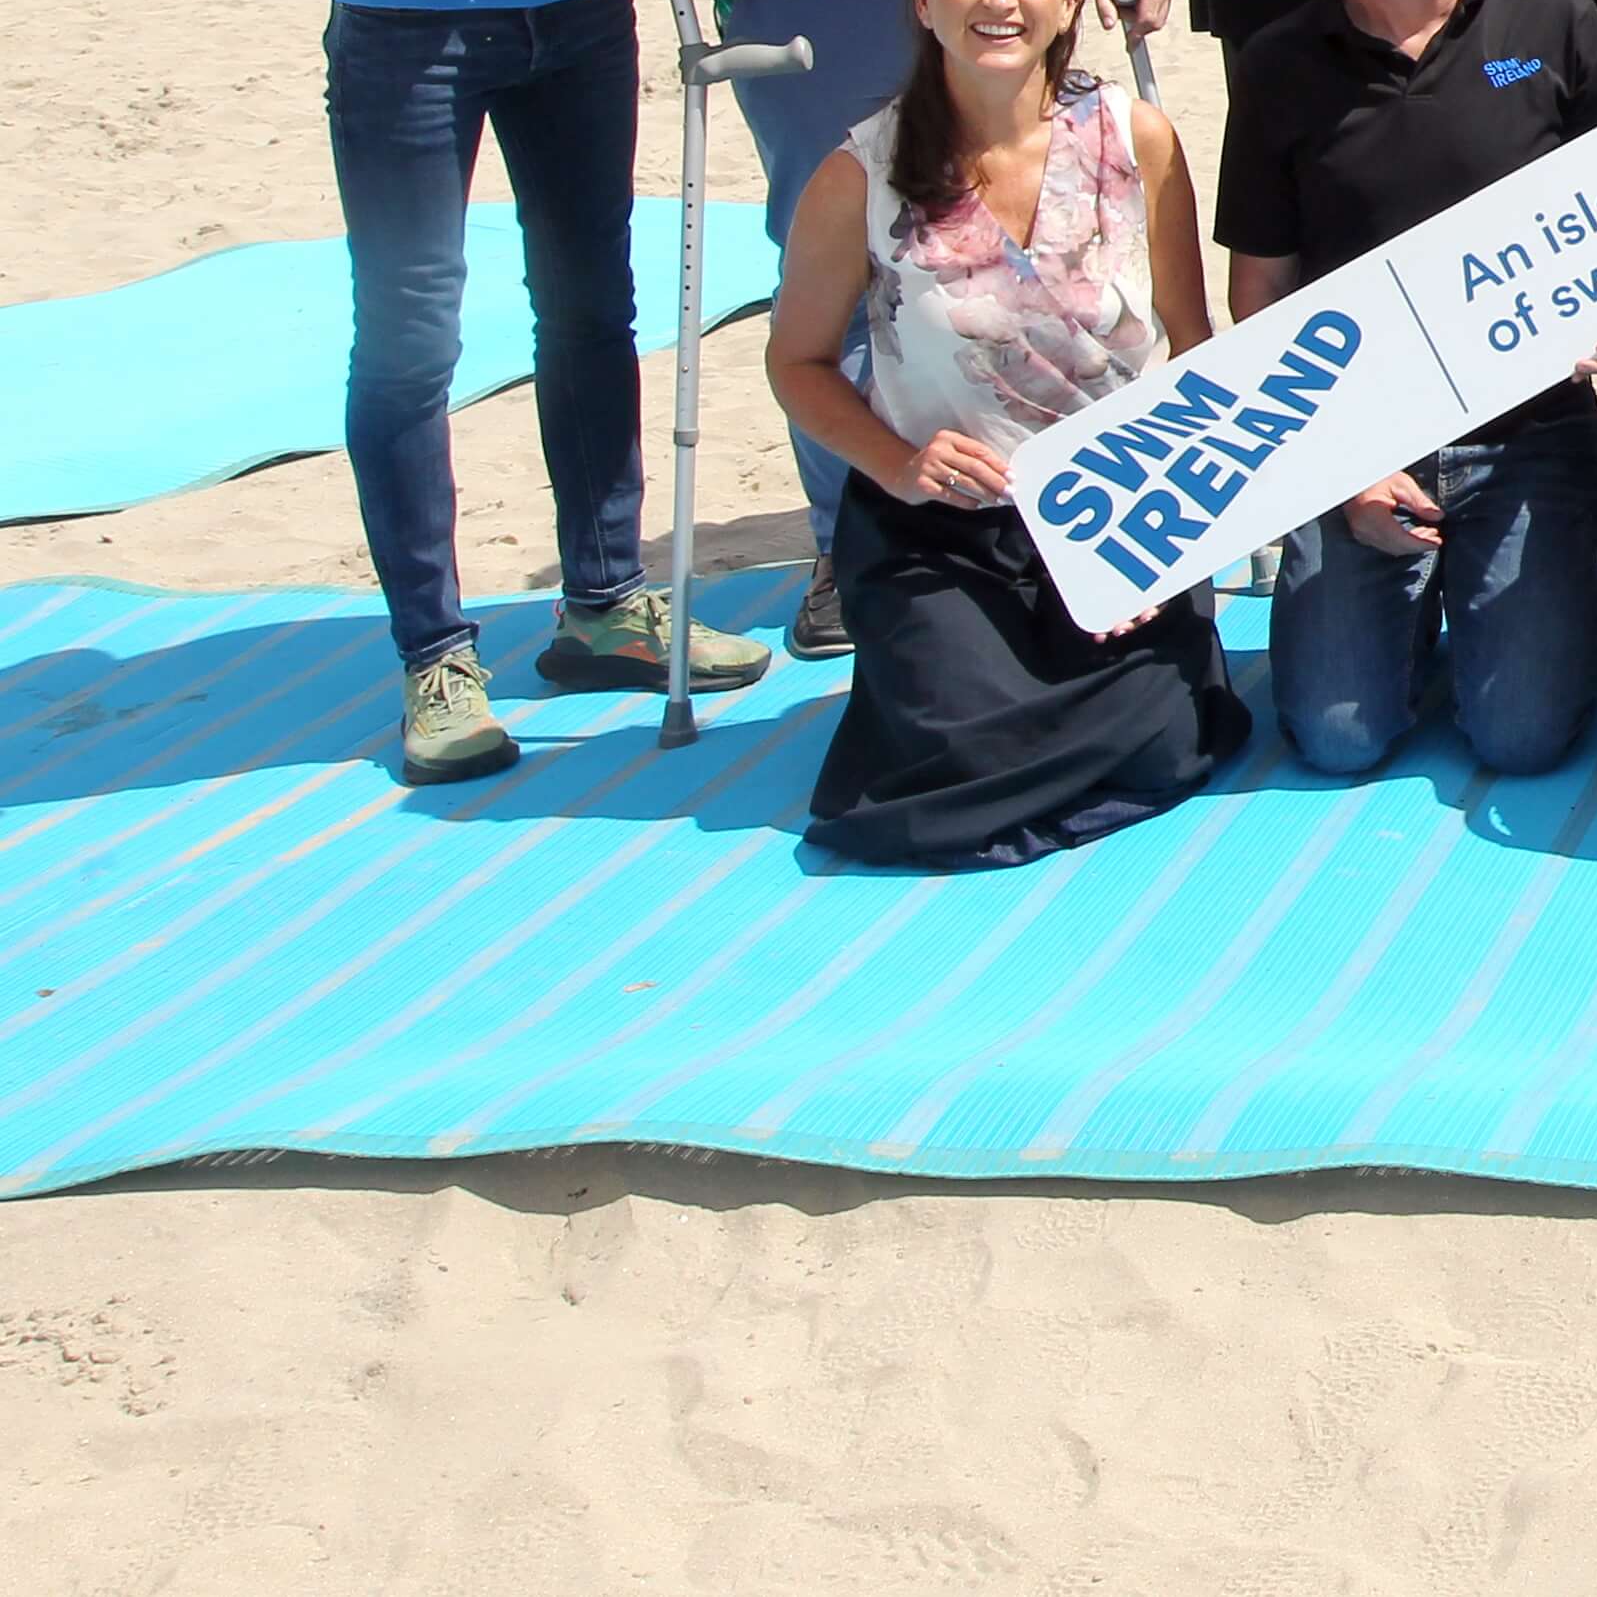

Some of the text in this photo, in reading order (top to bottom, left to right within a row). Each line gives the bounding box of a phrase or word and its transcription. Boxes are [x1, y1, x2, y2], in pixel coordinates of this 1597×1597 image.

[1490, 58, 1541, 88] IRELAND
[1461, 243, 1530, 303] An
[1487, 291, 1540, 353] of
[1037, 368, 1239, 544] SWIM
[1094, 308, 1363, 593] IRELAND
